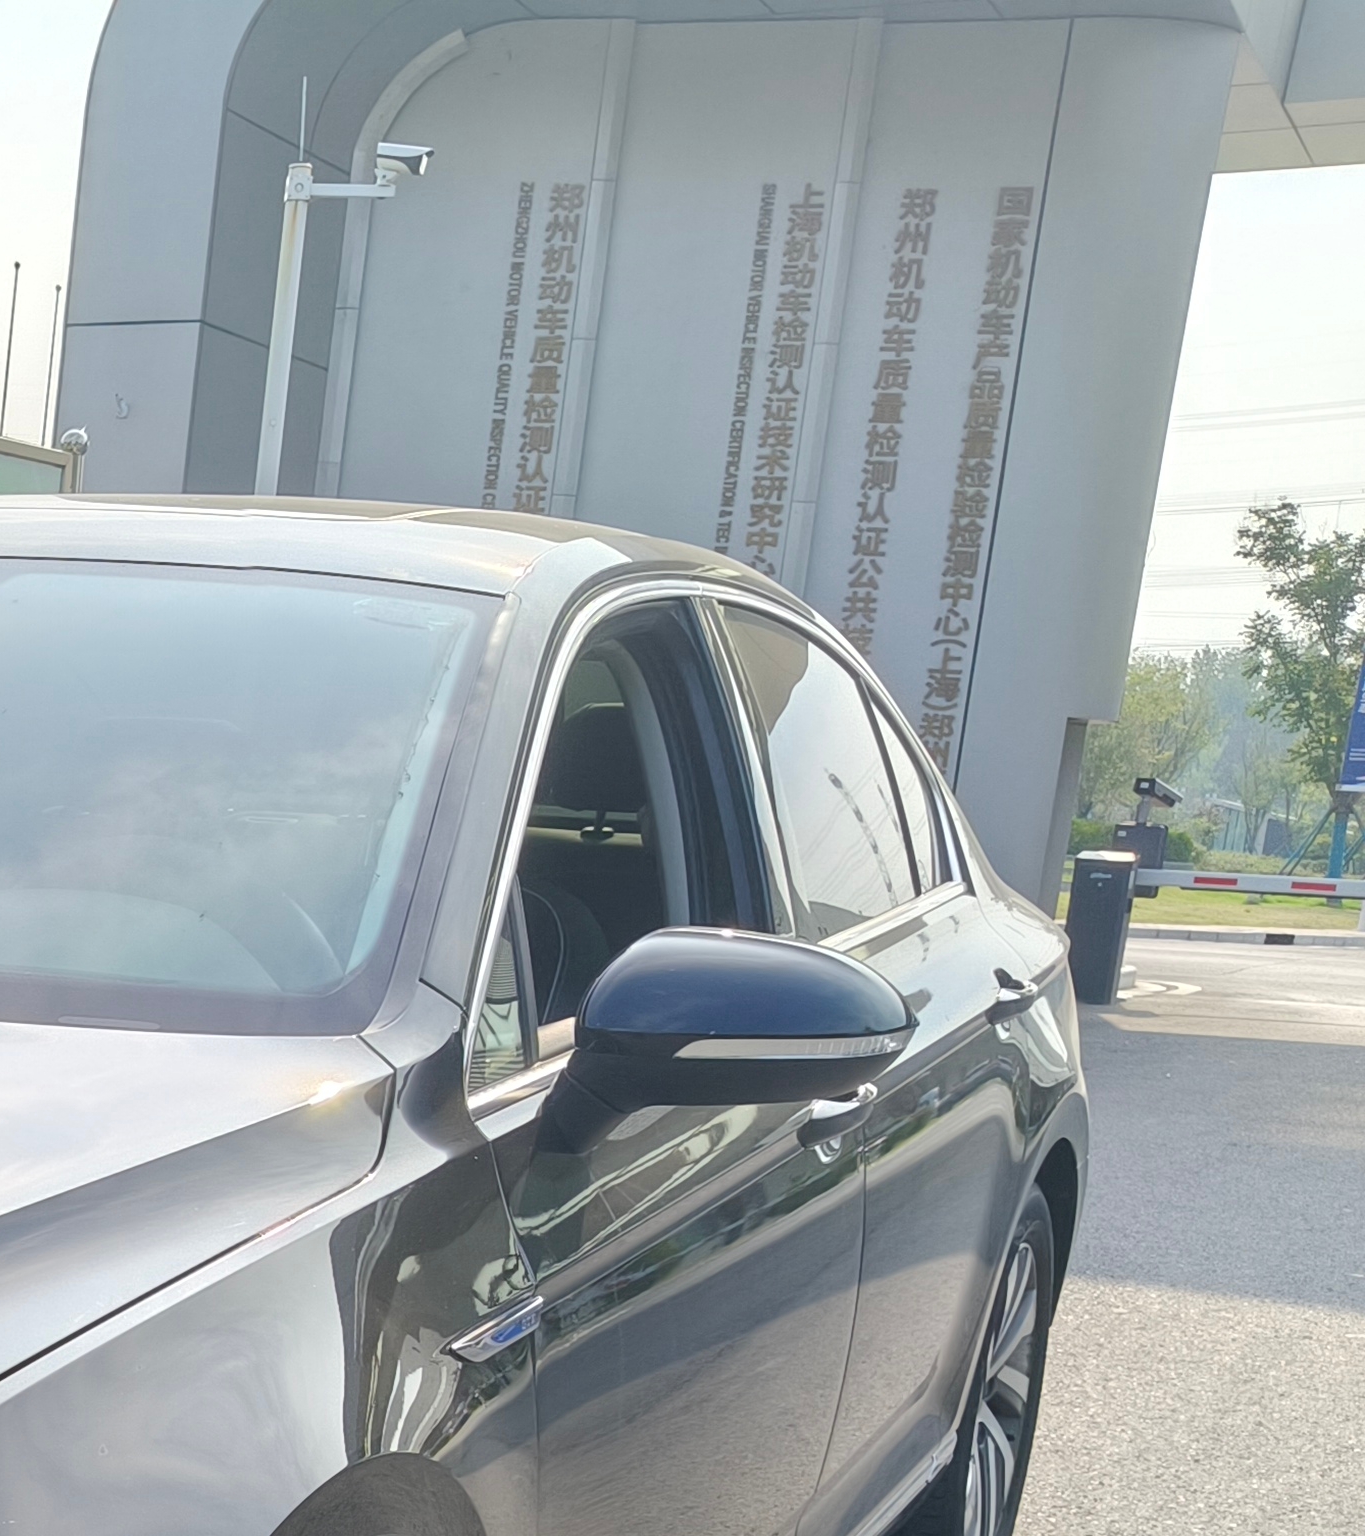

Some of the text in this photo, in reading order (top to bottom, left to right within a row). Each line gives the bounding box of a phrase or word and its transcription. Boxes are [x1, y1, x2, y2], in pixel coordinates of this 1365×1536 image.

[511, 182, 535, 258] ZHENGZHOU
[755, 183, 777, 246] SHANGHAI
[505, 262, 525, 306] MOTOR
[749, 248, 769, 292] MOTOR
[499, 309, 519, 360] VEHICLE
[741, 294, 764, 345] VEHICLE
[492, 363, 512, 415] QUALITY
[732, 347, 756, 417] INSPECTION
[483, 418, 506, 490] INSPECTION
[720, 419, 747, 507] CERTIFICATION
